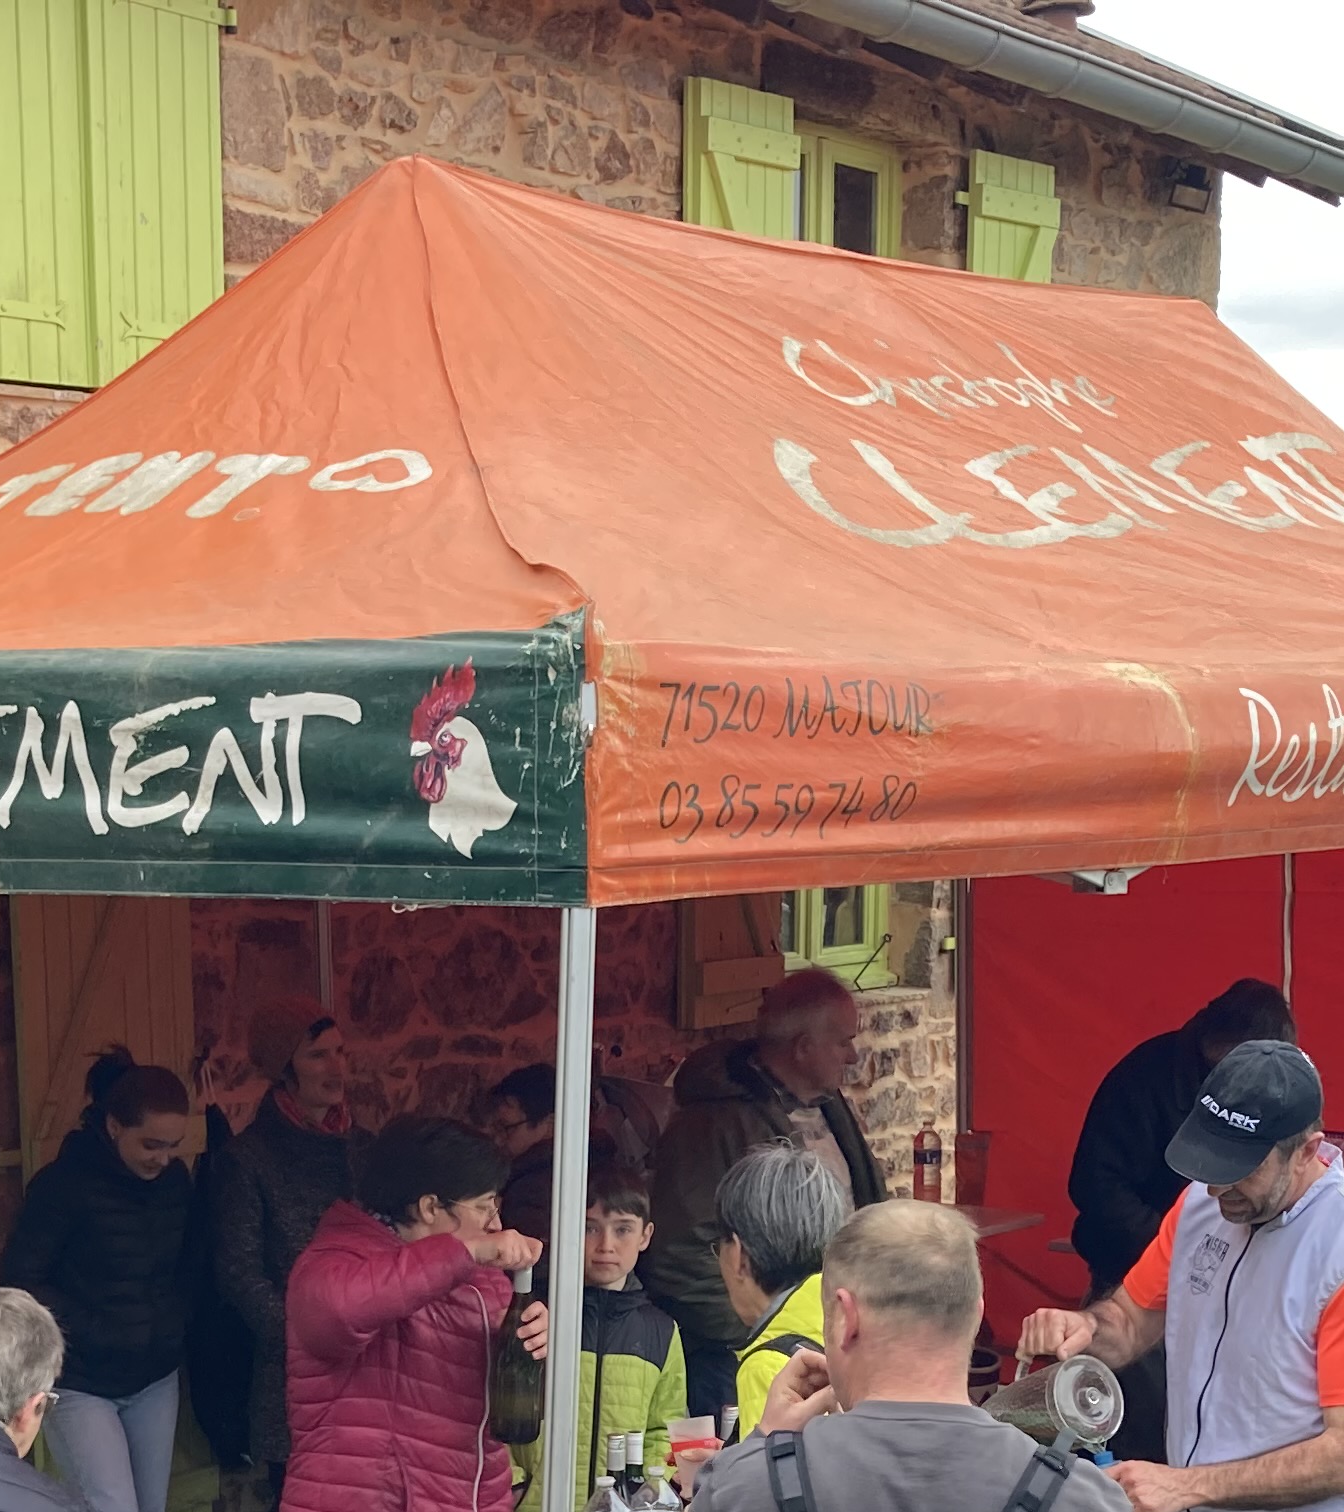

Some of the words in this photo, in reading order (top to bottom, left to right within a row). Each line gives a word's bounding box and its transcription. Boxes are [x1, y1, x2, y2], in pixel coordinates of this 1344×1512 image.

[659, 680, 765, 748] 71520
[659, 781, 704, 844] 03
[714, 774, 762, 839] 85
[760, 783, 816, 838] 59
[818, 776, 865, 840] 74
[868, 774, 918, 822] 80
